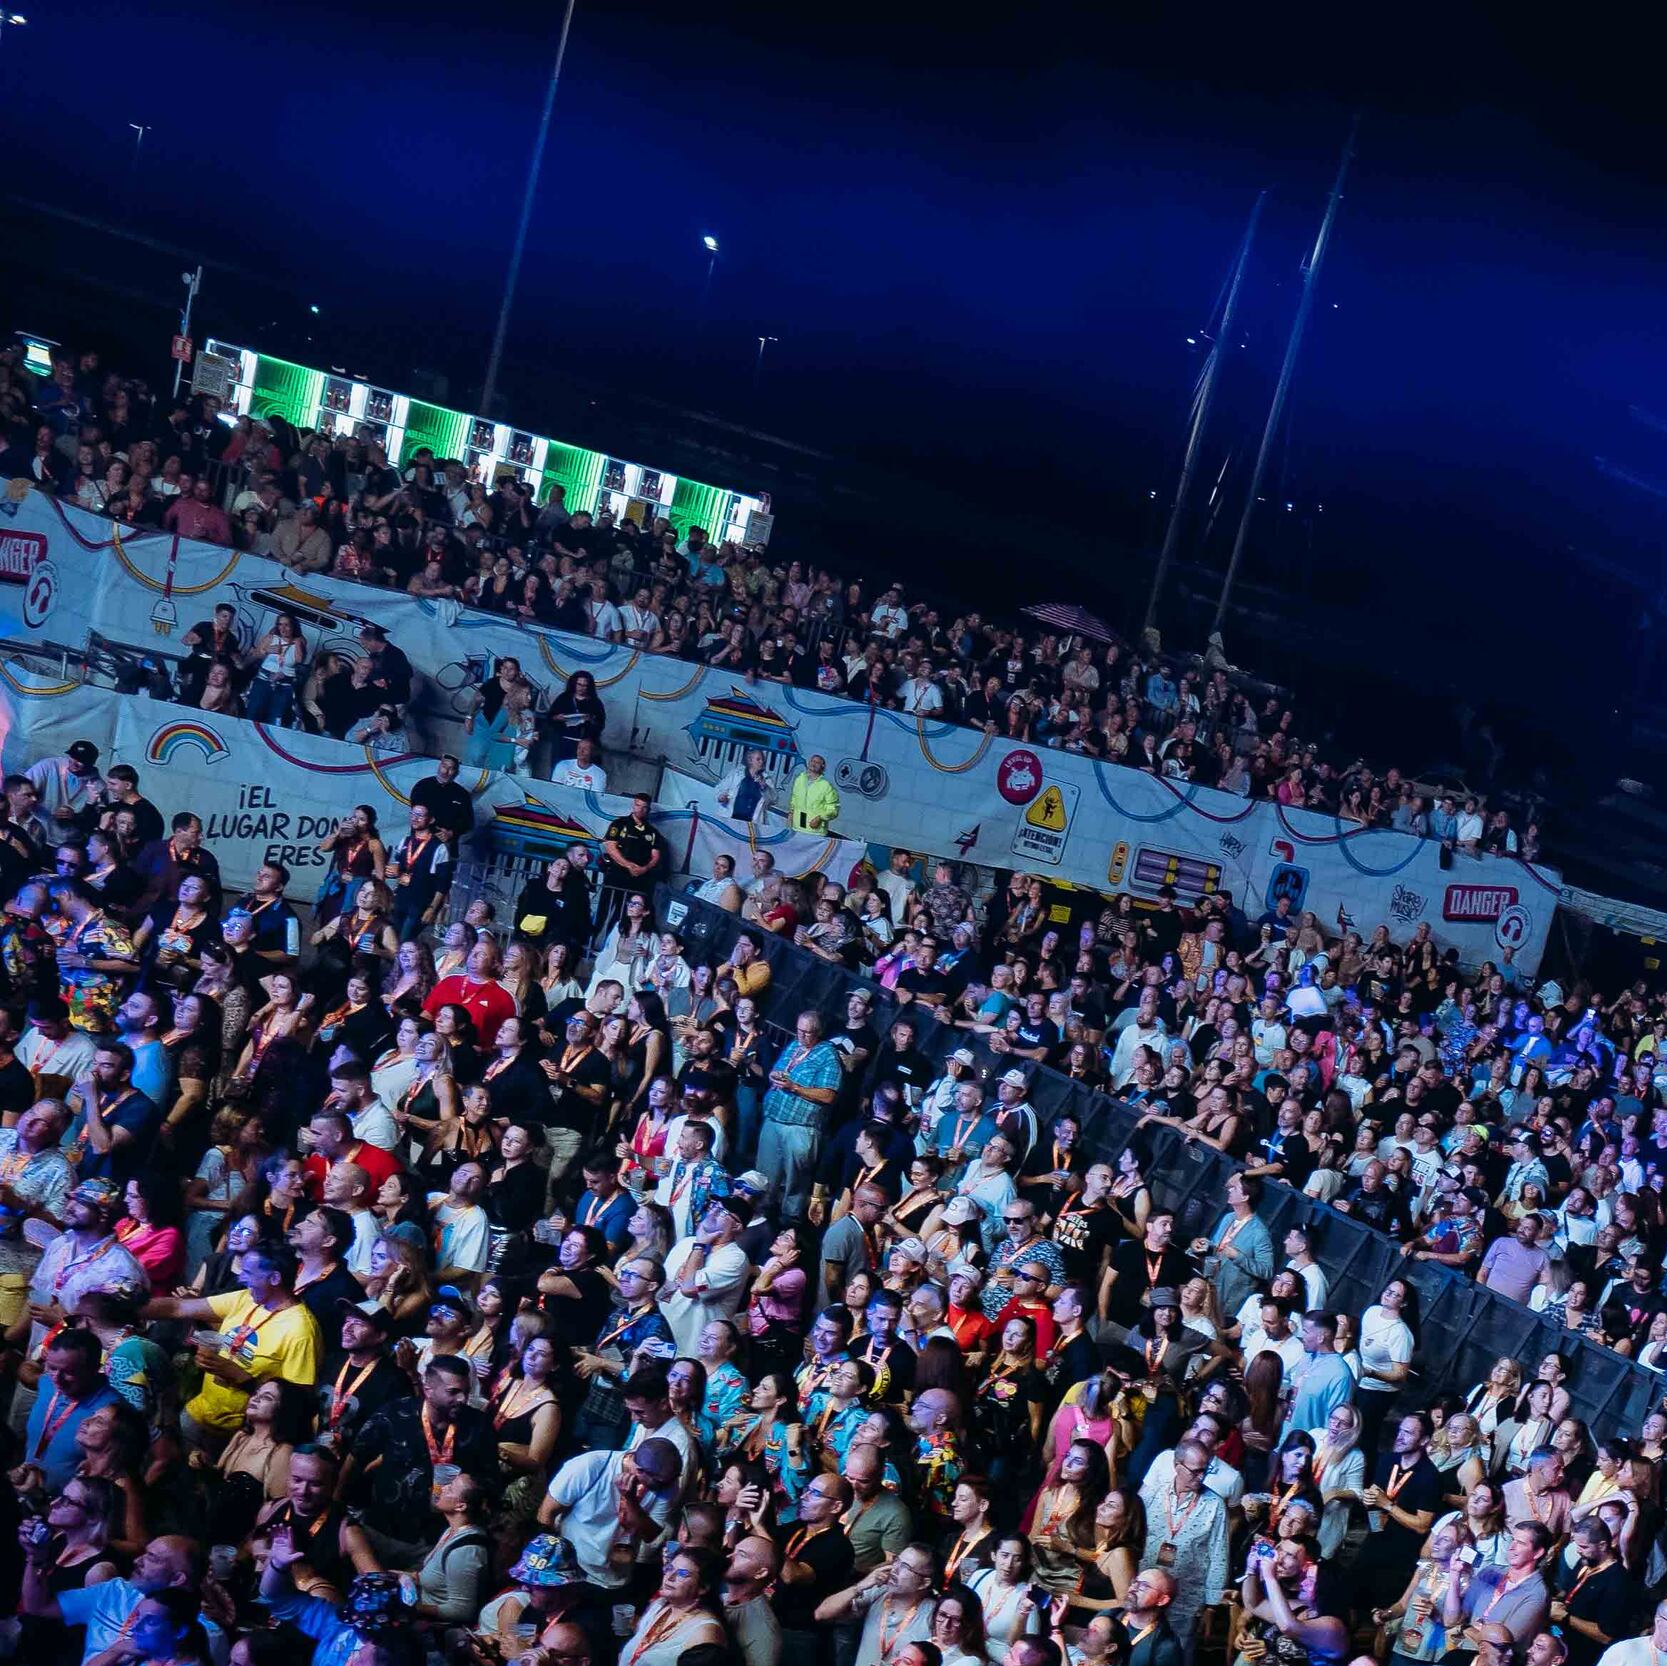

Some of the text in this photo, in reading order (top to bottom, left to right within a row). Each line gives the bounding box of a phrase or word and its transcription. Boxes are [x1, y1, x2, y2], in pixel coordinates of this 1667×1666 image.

[0, 536, 39, 574] NGER
[206, 813, 290, 840] LUGAR
[264, 844, 326, 867] ERES
[1449, 889, 1511, 916] DANGER
